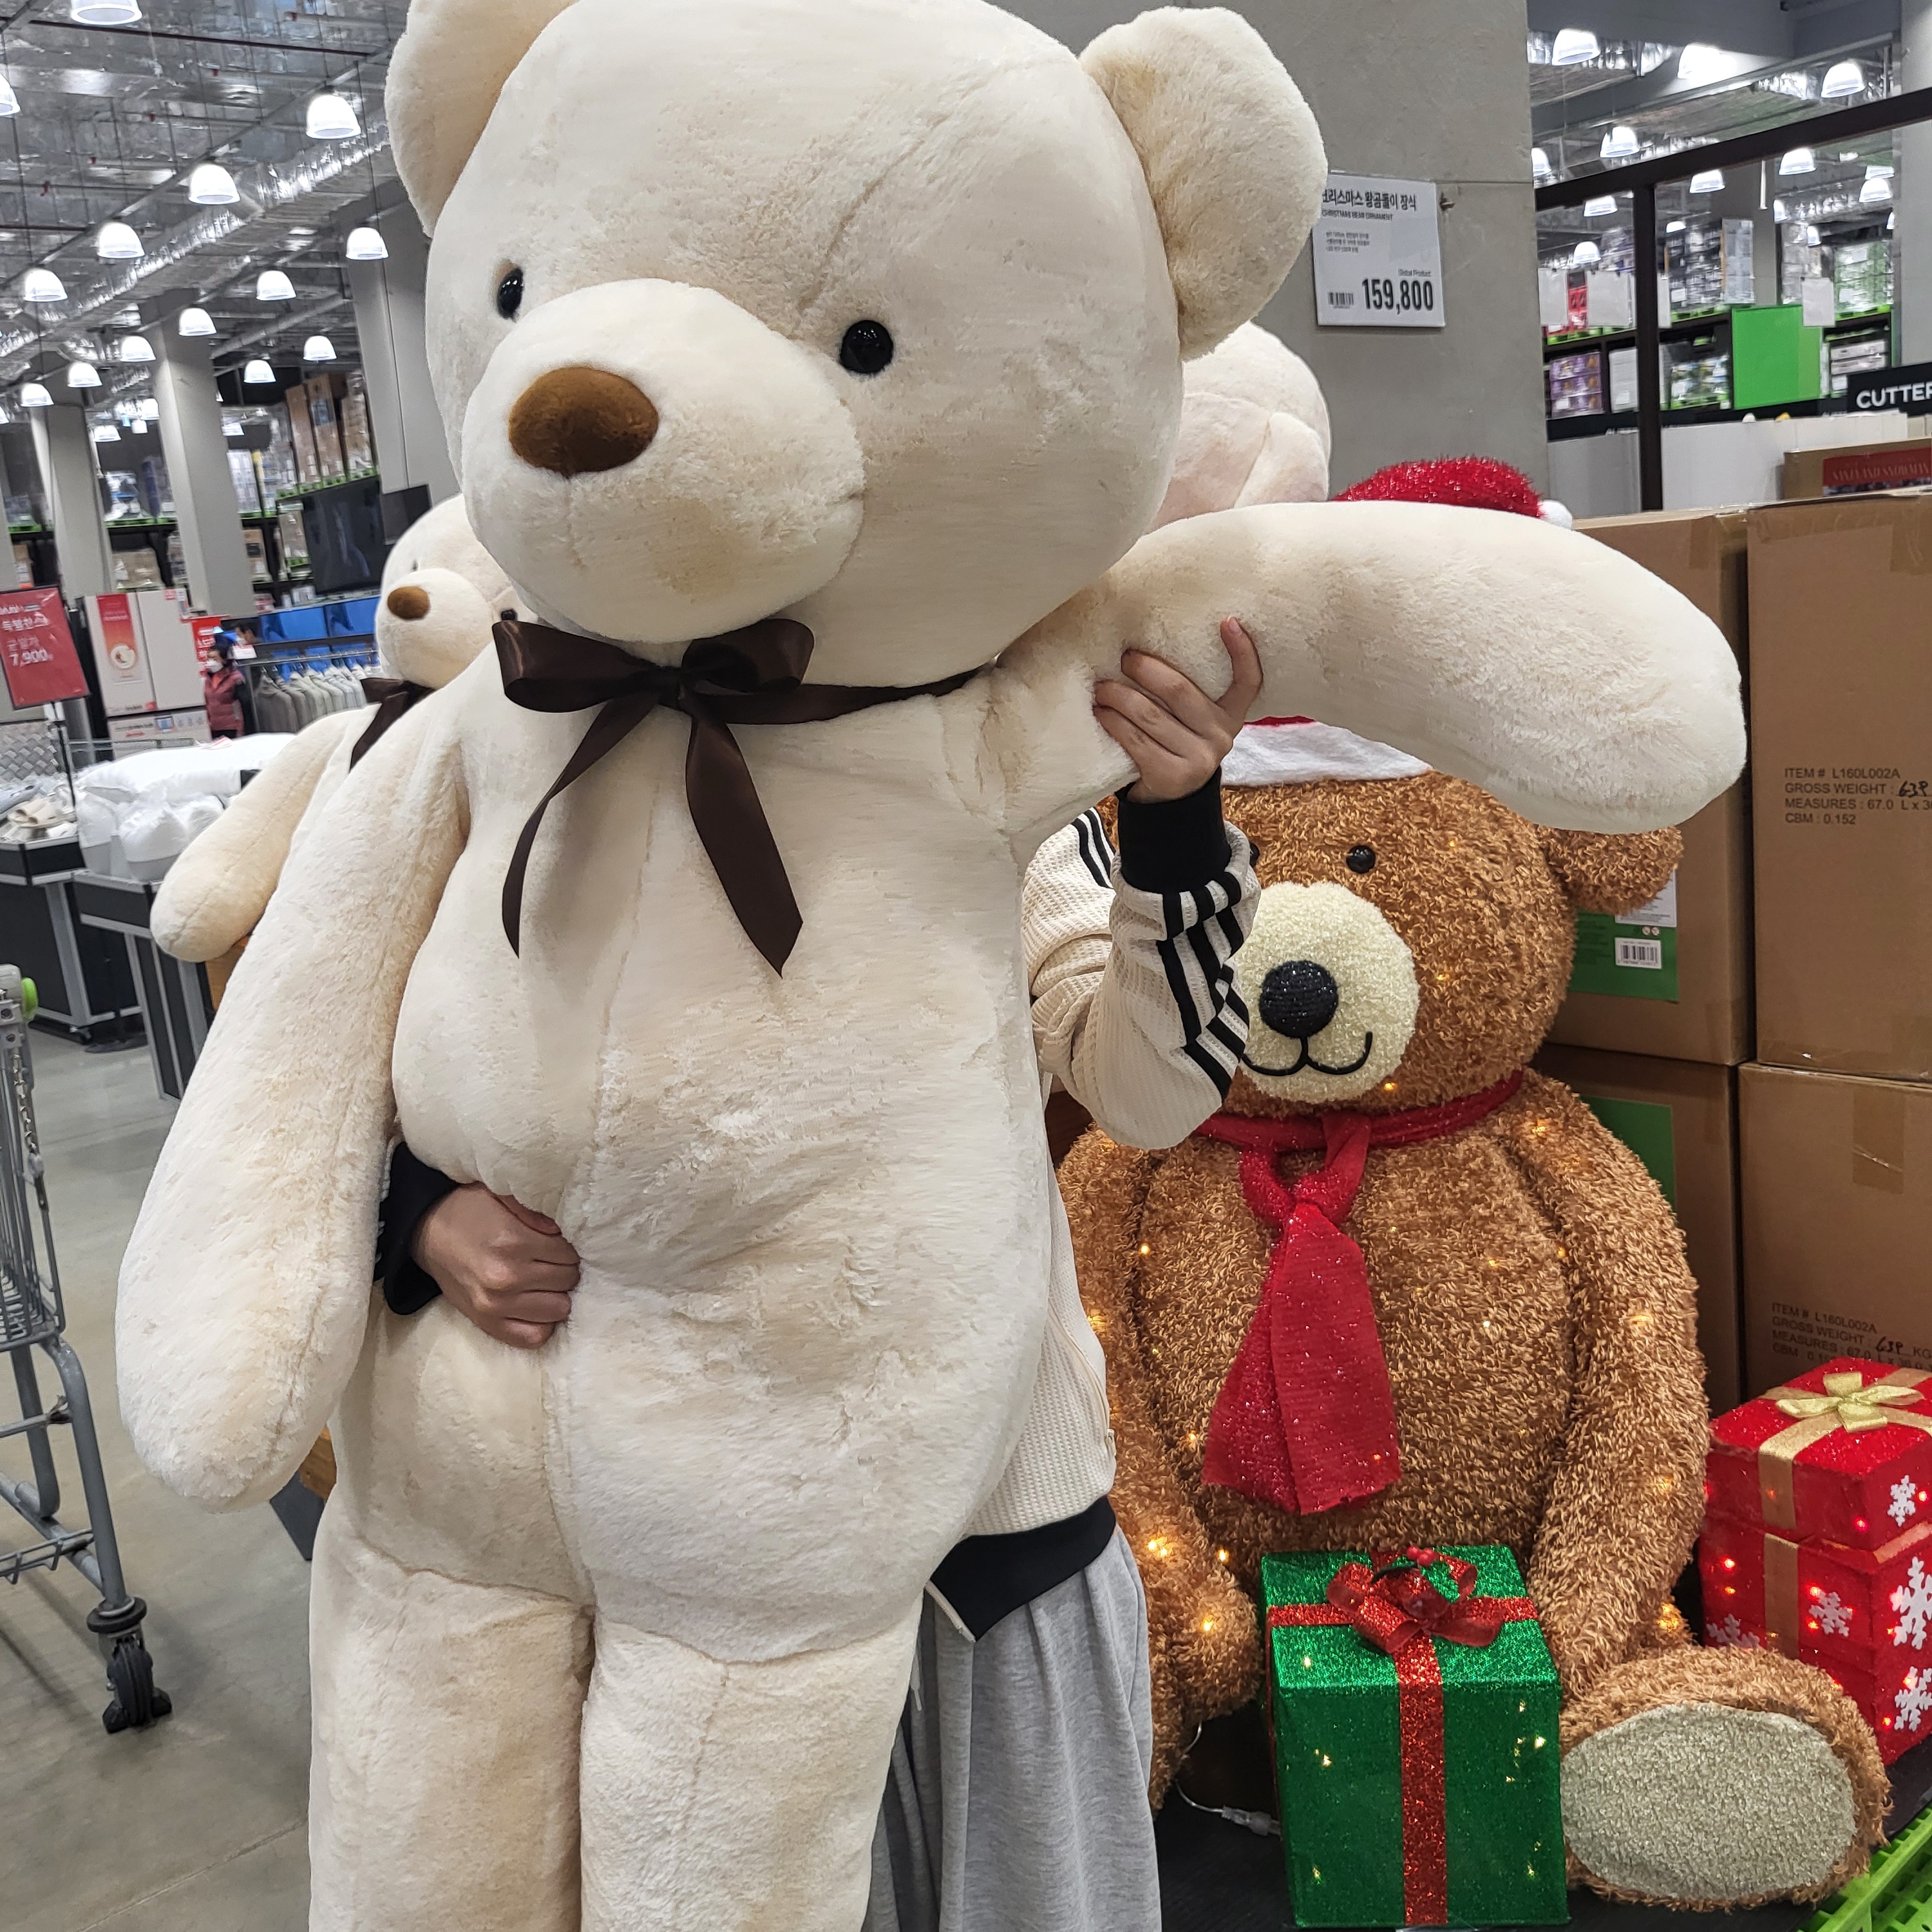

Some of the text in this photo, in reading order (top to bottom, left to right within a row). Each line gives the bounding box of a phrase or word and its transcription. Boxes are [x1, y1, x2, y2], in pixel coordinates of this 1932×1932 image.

[1362, 278, 1434, 315] 159,800
[1785, 768, 1815, 778] ITEM
[1832, 768, 1900, 779] L160L002A
[1785, 783, 1830, 794] GROSS
[1833, 783, 1887, 795] WEIGHT
[1785, 798, 1857, 810] MEASURES
[1868, 799, 1894, 810] 67.0
[1901, 799, 1908, 810] L
[1923, 800, 1932, 811] 3
[1785, 813, 1813, 824] CBM
[1823, 813, 1856, 824] 0.152
[1772, 1302, 1799, 1318] ITEM
[1772, 1316, 1814, 1333] GROSS
[1816, 1325, 1864, 1345] WEIGHT
[1772, 1330, 1838, 1352] MEASURES
